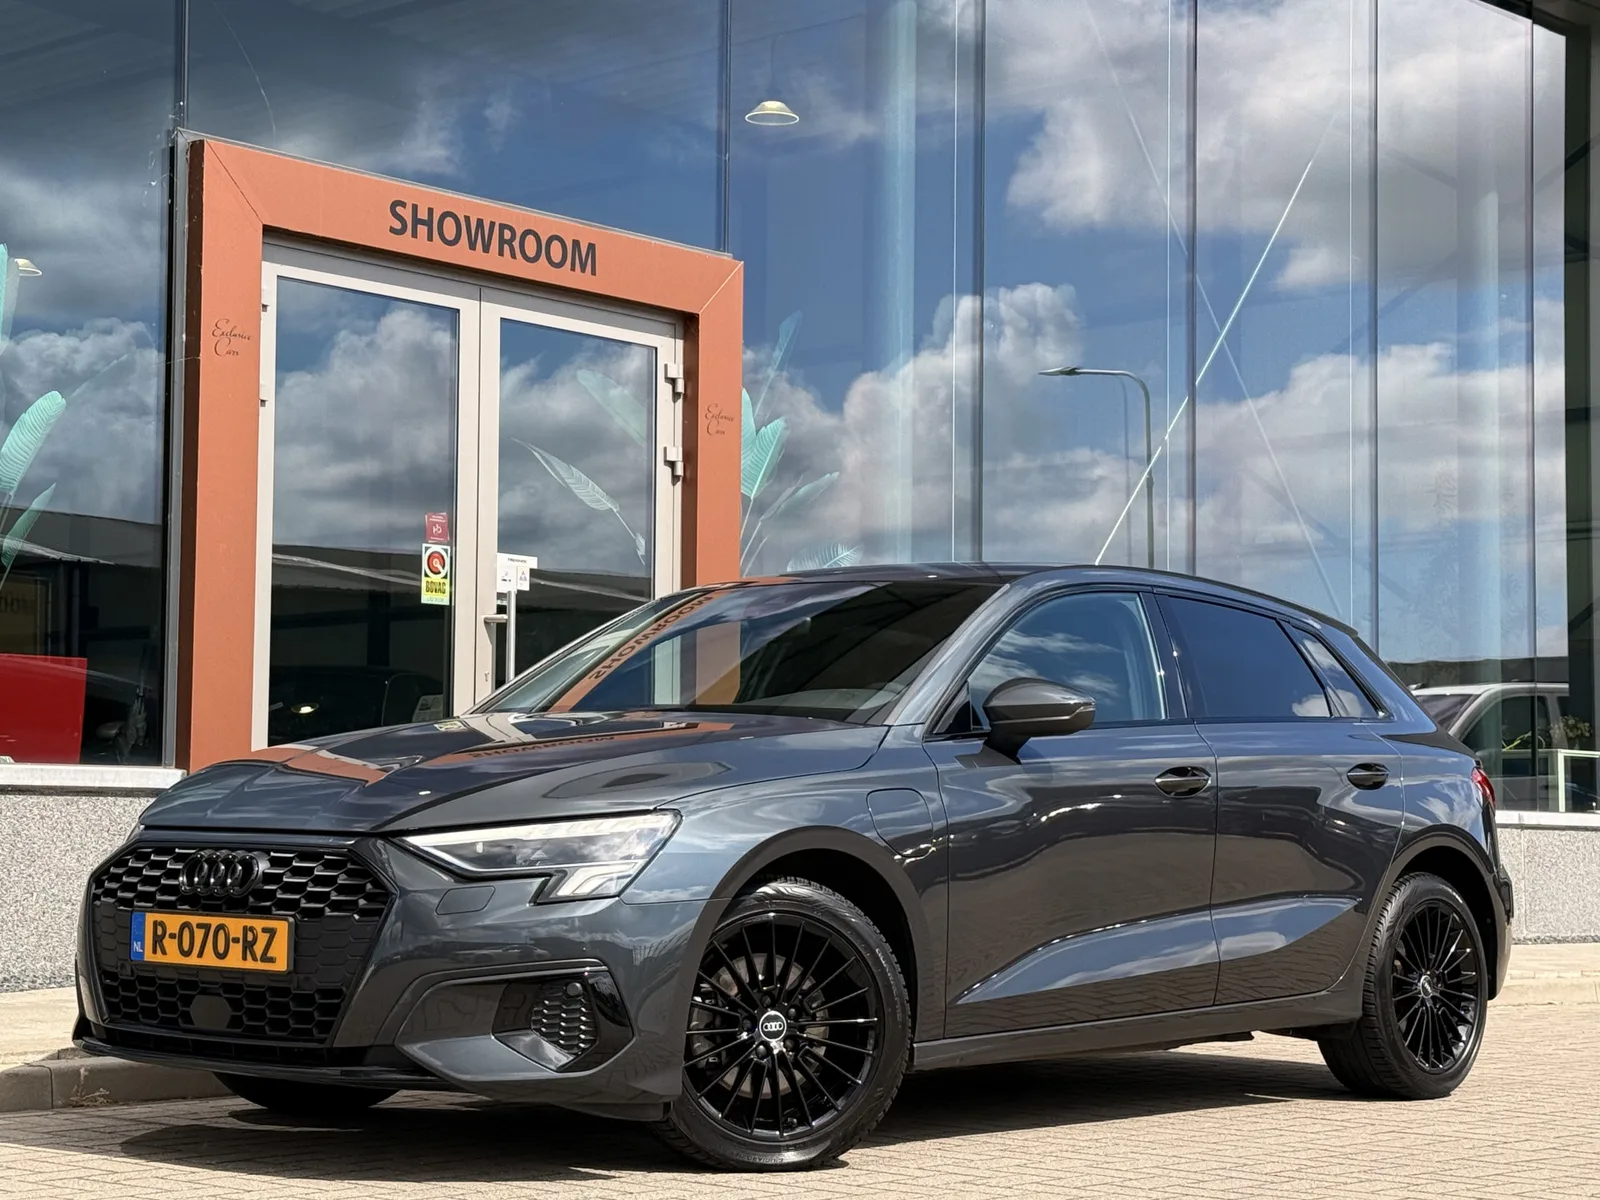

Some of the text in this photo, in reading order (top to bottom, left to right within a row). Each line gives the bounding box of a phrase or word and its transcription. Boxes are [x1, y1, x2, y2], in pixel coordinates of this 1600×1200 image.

[389, 200, 597, 277] SHOWROOM
[211, 318, 252, 341] Exclusive
[214, 337, 240, 357] Cars
[425, 580, 447, 596] BOVAG
[133, 920, 278, 964] NL R-070-RZ
